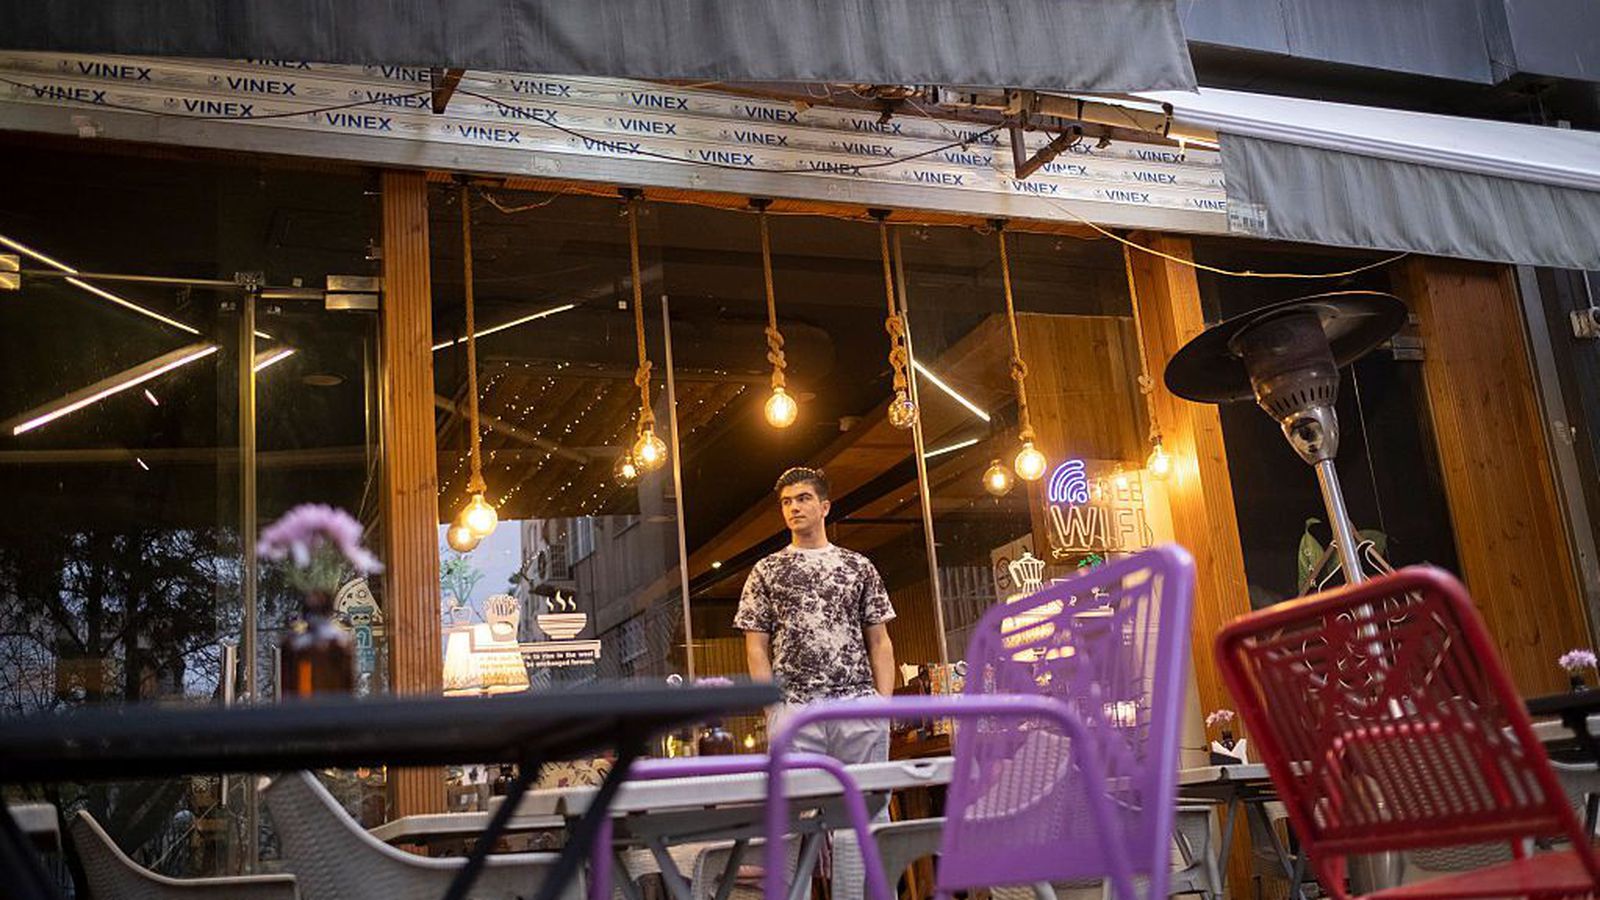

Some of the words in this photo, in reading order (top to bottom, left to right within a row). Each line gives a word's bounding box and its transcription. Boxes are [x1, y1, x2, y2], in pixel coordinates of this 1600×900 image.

[78, 61, 152, 82] VINEX
[381, 65, 432, 82] VINE
[227, 76, 297, 97] VINEX
[511, 80, 572, 98] VINEX
[183, 98, 254, 118] VINEX
[367, 91, 432, 109] VINEX
[632, 92, 690, 111] VINEX
[326, 112, 392, 131] VINEX
[499, 105, 558, 123] VINEX
[746, 105, 800, 124] VINEX
[458, 124, 521, 144] VINEX
[620, 117, 677, 136] VINEX
[852, 118, 902, 136] VINEX
[583, 137, 642, 155] VINEX
[734, 130, 790, 148] VINEX
[699, 150, 755, 168] VINEX
[842, 141, 895, 159] VINEX
[1138, 149, 1183, 164] VINEX
[945, 152, 993, 169] VINEX
[914, 170, 965, 187] VINEX
[1043, 163, 1090, 178] VINEX
[1133, 171, 1178, 186] VINEX
[1013, 180, 1060, 195] VINEX
[1105, 189, 1151, 205] VINEX
[1194, 198, 1227, 212] VINE
[1050, 505, 1149, 549] WIFI
